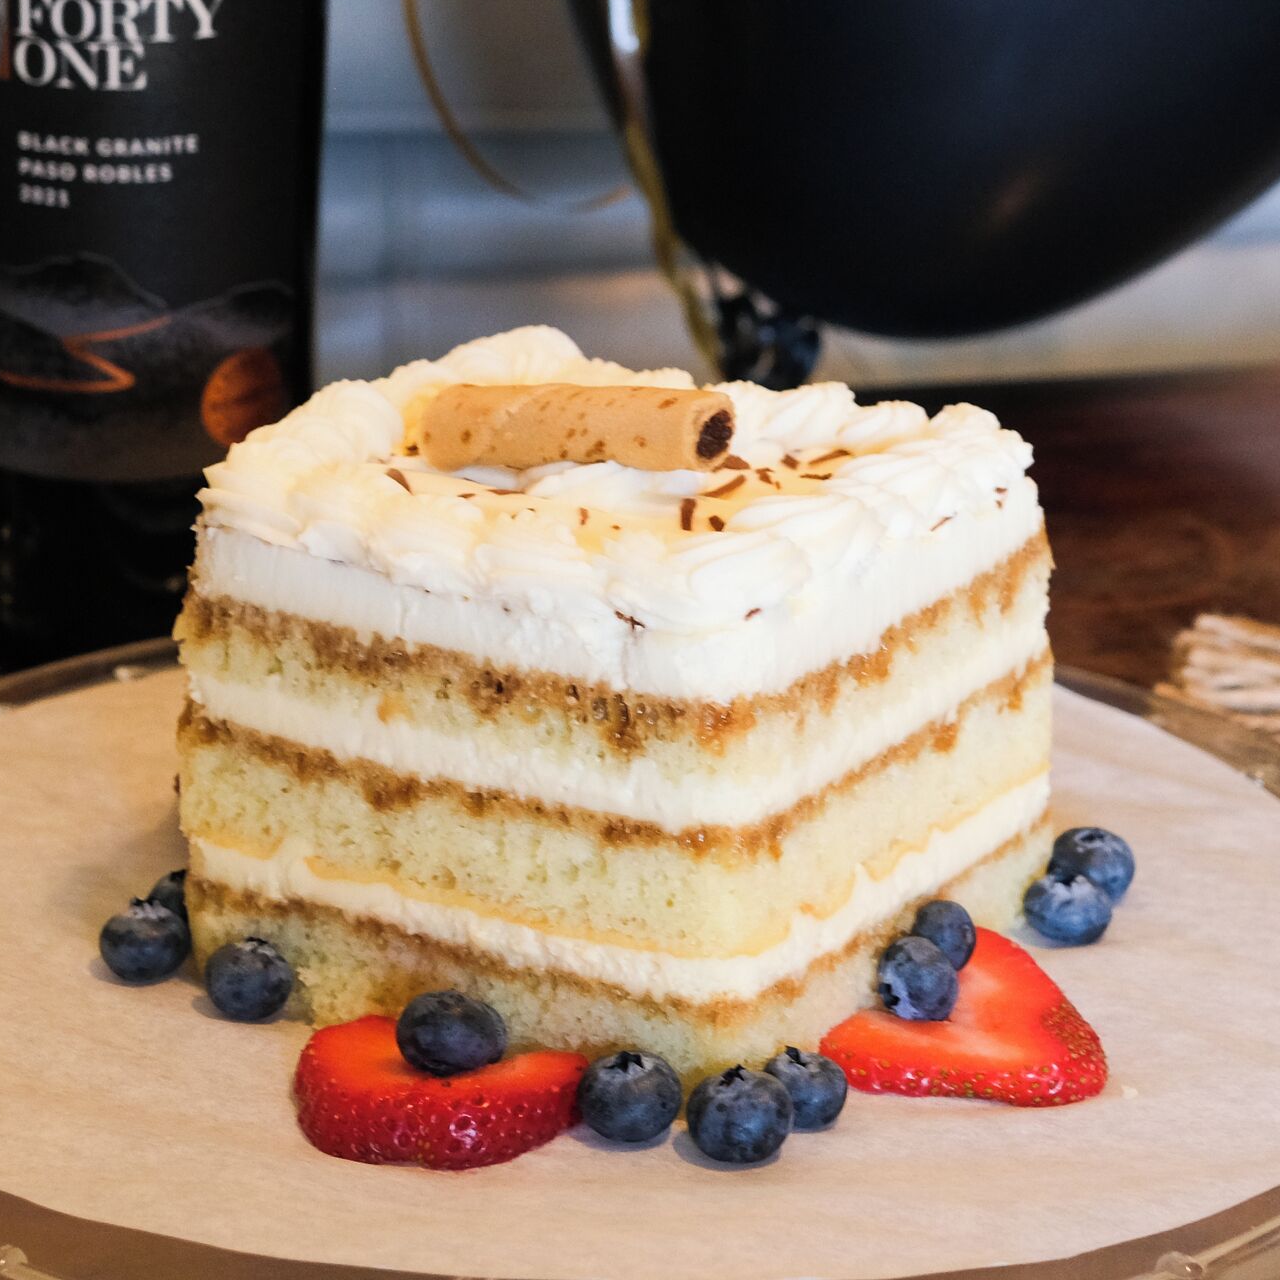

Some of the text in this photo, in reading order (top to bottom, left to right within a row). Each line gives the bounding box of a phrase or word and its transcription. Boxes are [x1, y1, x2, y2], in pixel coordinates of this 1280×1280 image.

[13, 36, 148, 91] ONE
[18, 131, 199, 157] BLACK GRANITE
[18, 157, 173, 184] PASO ROBLES
